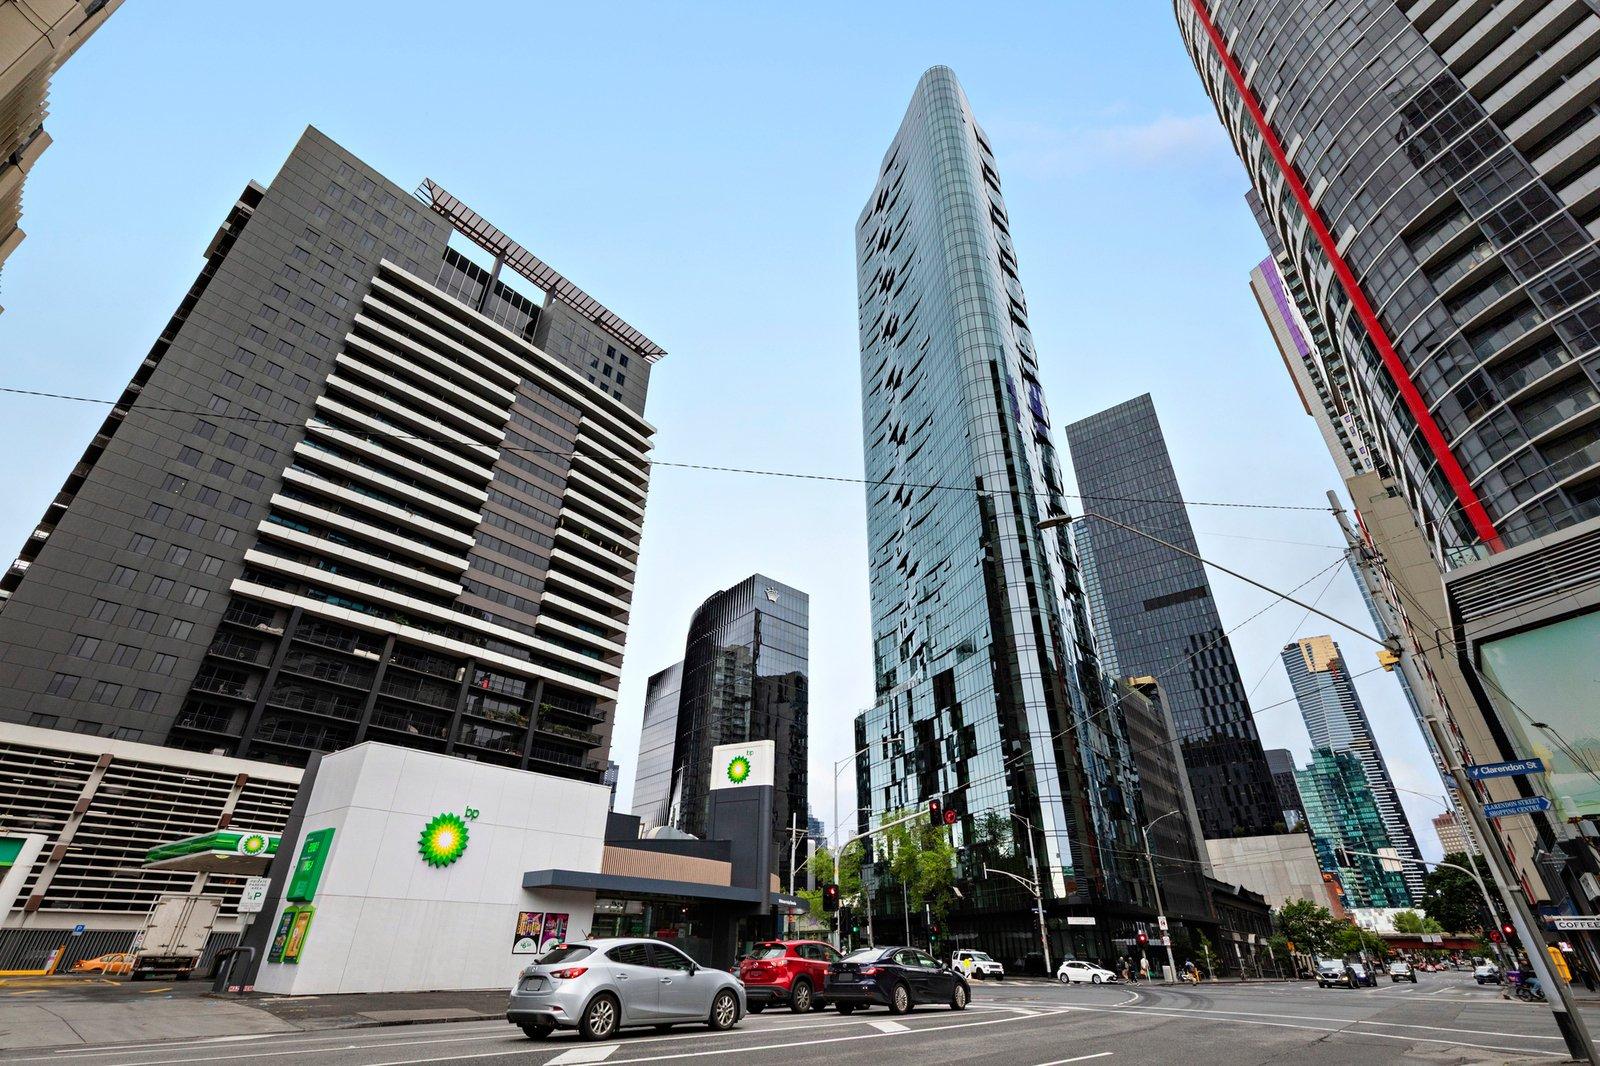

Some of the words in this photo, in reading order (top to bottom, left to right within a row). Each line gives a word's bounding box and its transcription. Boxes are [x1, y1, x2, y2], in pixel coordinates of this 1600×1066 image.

[1480, 763, 1525, 774] Clarendon
[1525, 761, 1538, 769] St
[1484, 801, 1517, 811] CLARENDON
[1517, 798, 1540, 806] STREET
[1489, 807, 1516, 816] SHOPPING
[1517, 804, 1540, 813] CENTRE
[464, 805, 480, 821] bp
[1559, 921, 1600, 929] COFFEE
